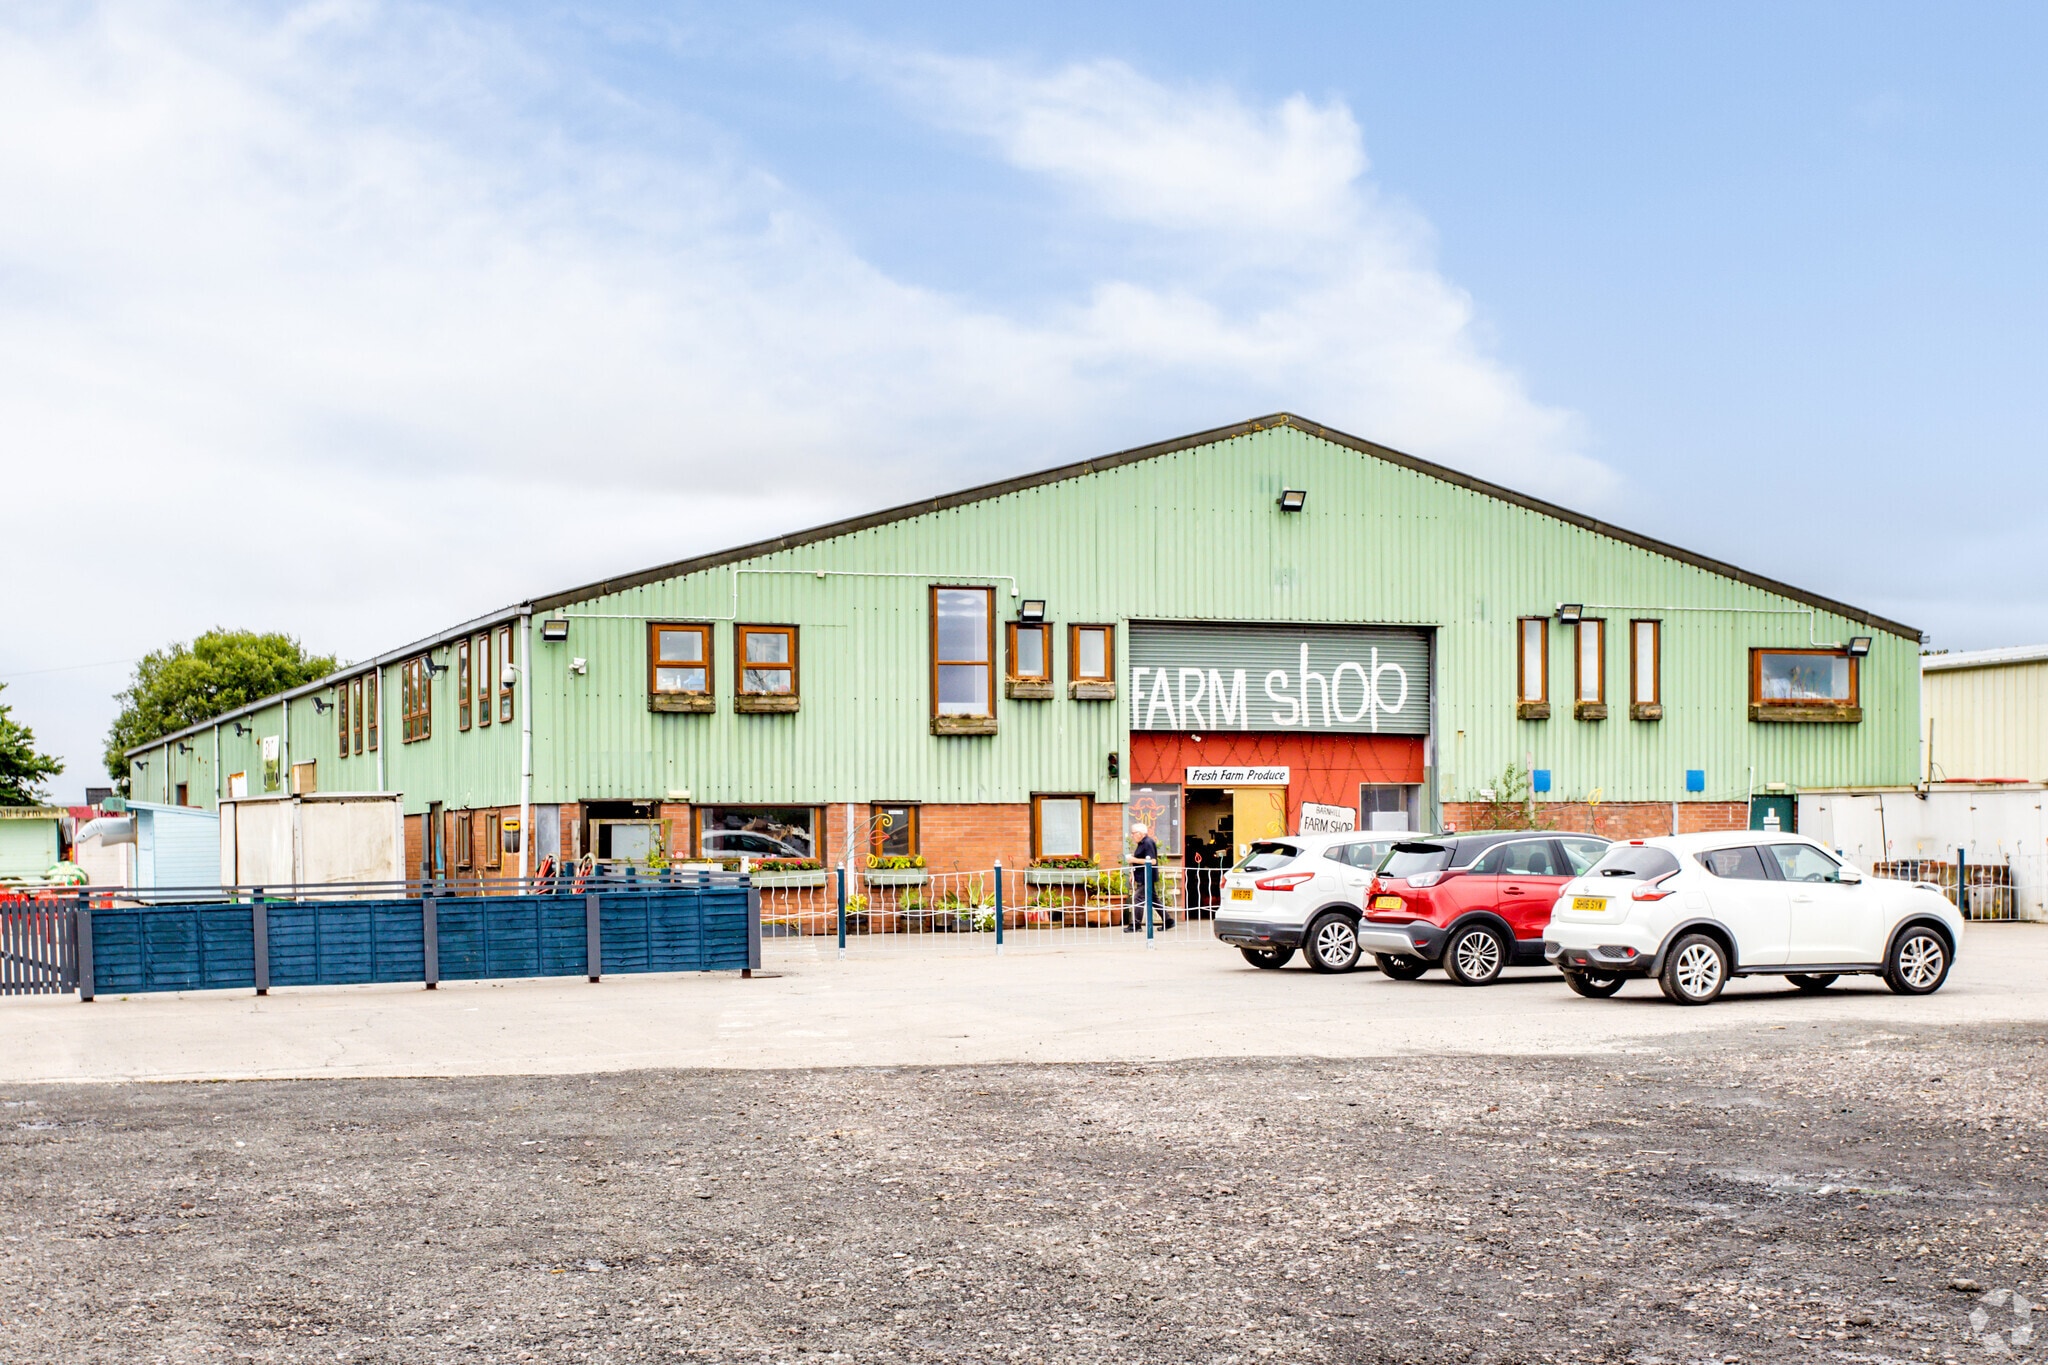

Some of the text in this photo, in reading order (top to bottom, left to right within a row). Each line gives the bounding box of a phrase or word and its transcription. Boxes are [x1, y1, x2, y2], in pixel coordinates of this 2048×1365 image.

[1132, 642, 1408, 733] FARM shop
[1192, 769, 1286, 780] Fresh Farm Produce
[1315, 806, 1341, 817] BARNHILL
[1304, 816, 1353, 833] FARM SHOP
